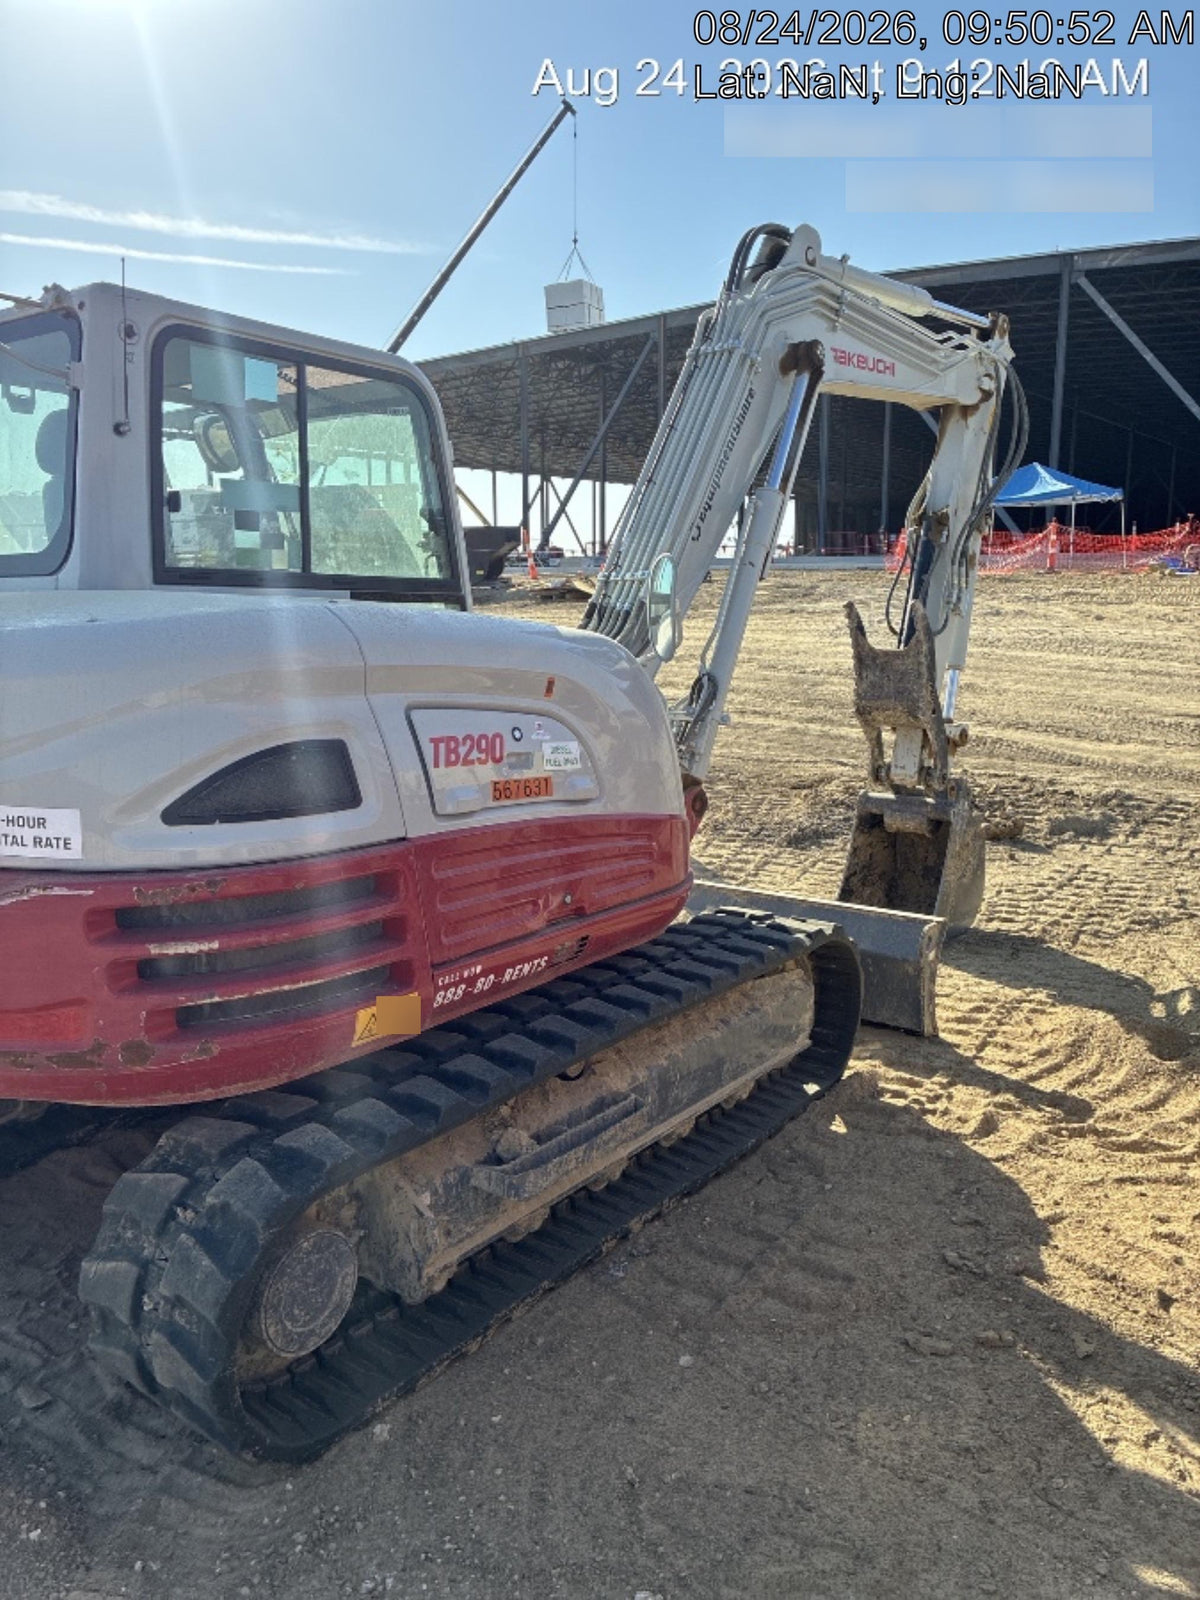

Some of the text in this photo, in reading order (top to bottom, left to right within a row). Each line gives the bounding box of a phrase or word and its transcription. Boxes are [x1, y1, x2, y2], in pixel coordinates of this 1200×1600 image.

[429, 732, 504, 768] TB290
[492, 778, 550, 801] 567631
[0, 833, 72, 850] TAL RATE
[438, 971, 460, 986] CALL
